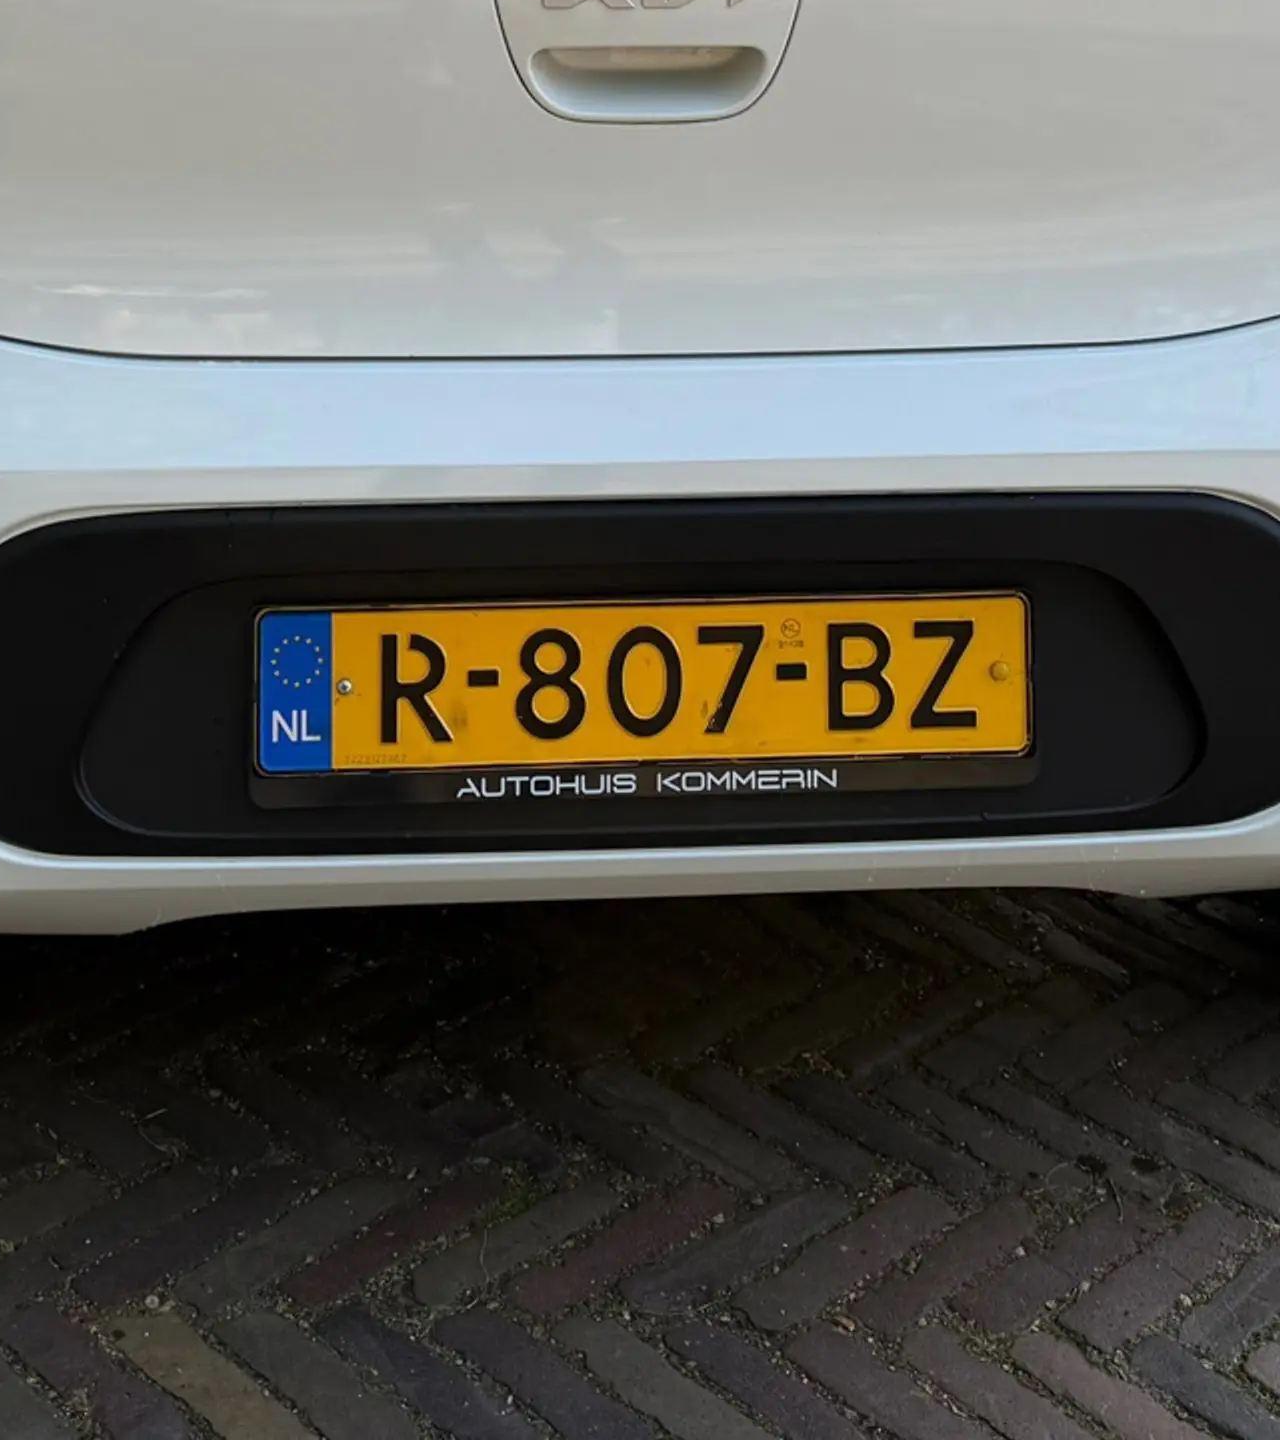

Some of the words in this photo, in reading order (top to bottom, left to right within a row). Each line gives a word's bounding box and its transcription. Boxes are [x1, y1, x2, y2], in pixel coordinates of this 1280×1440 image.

[272, 710, 321, 743] NL
[379, 620, 978, 745] R-807-BZ
[456, 773, 637, 798] AUTOHUIS
[657, 769, 838, 792] KOMMERIN
